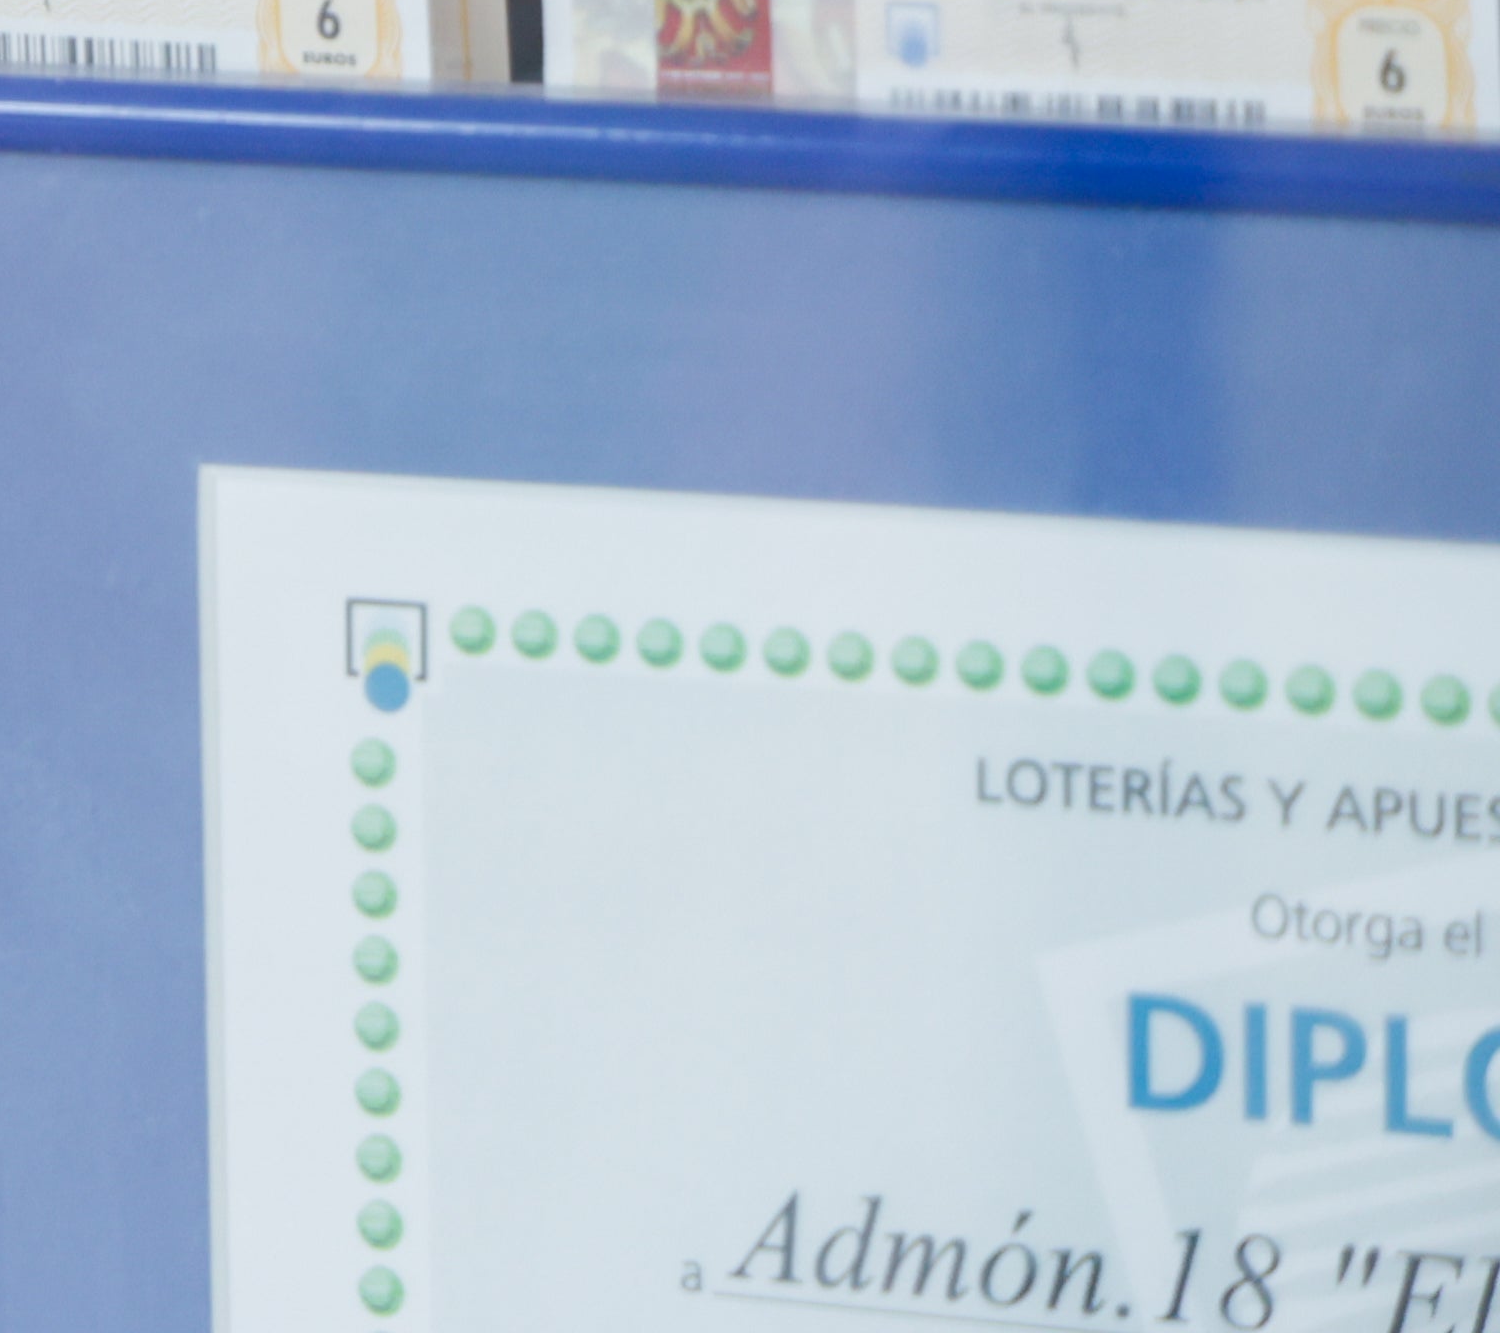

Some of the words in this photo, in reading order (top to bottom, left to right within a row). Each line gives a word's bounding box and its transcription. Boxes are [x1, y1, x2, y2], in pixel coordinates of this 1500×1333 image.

[976, 757, 1248, 822] LOTERÍAS
[1268, 779, 1308, 827] Y
[1250, 893, 1425, 959] Otorga
[1442, 910, 1485, 957] el
[679, 1260, 705, 1294] a
